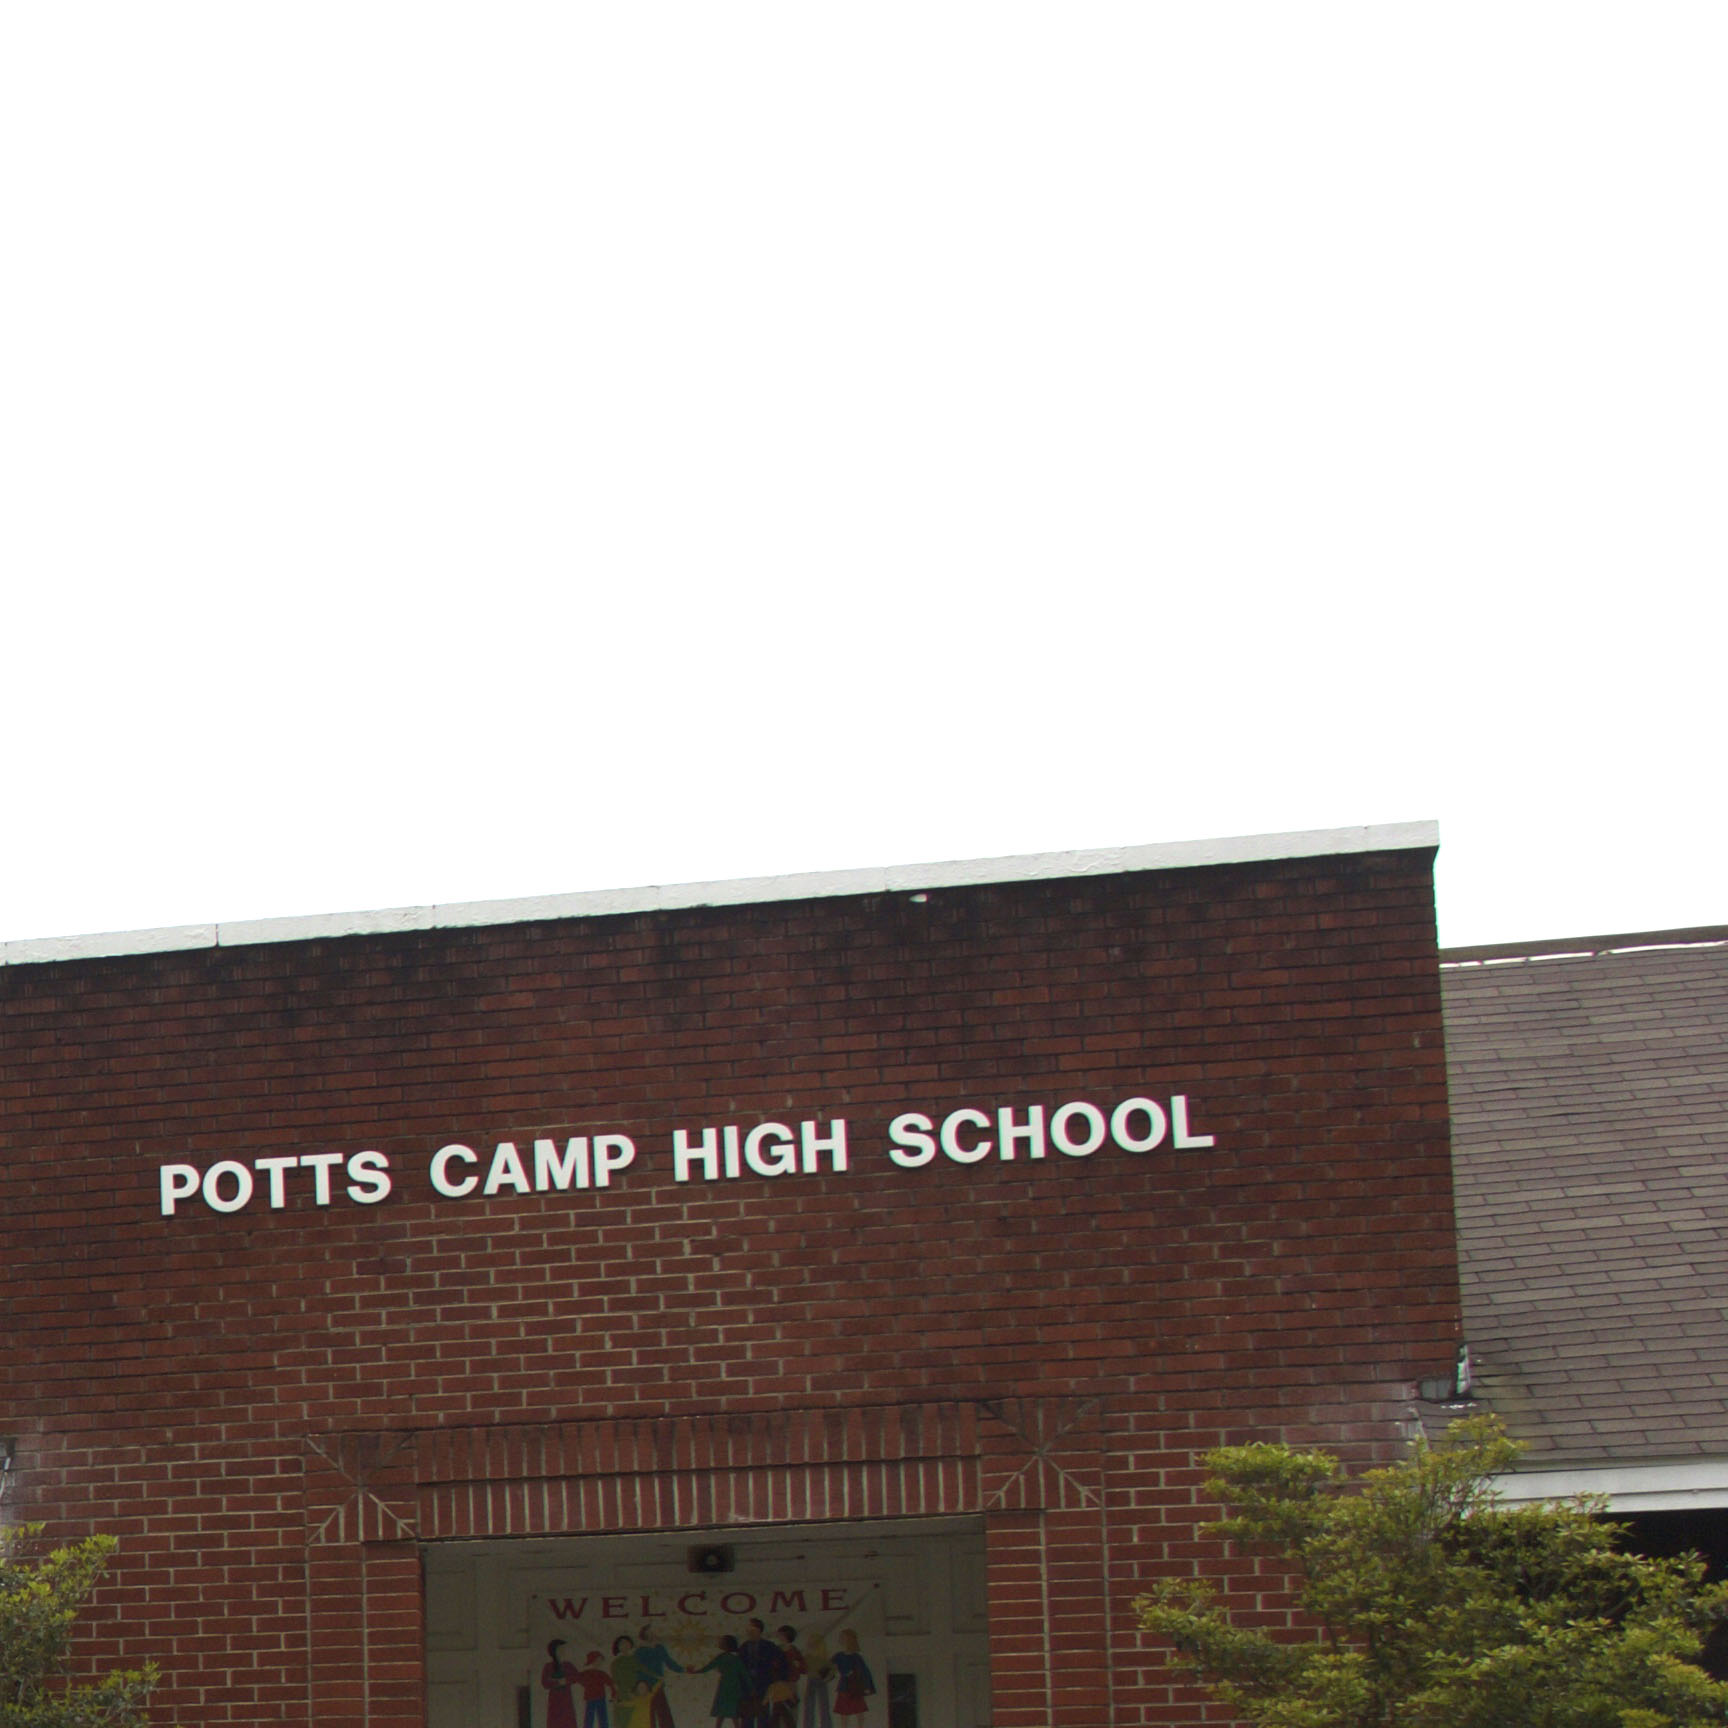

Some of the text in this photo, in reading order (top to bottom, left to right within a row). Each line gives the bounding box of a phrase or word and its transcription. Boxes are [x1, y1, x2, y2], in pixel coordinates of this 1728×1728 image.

[160, 1095, 1215, 1216] POTTS CAMP HIGH SCHOOL
[548, 1588, 850, 1620] WELCOME
